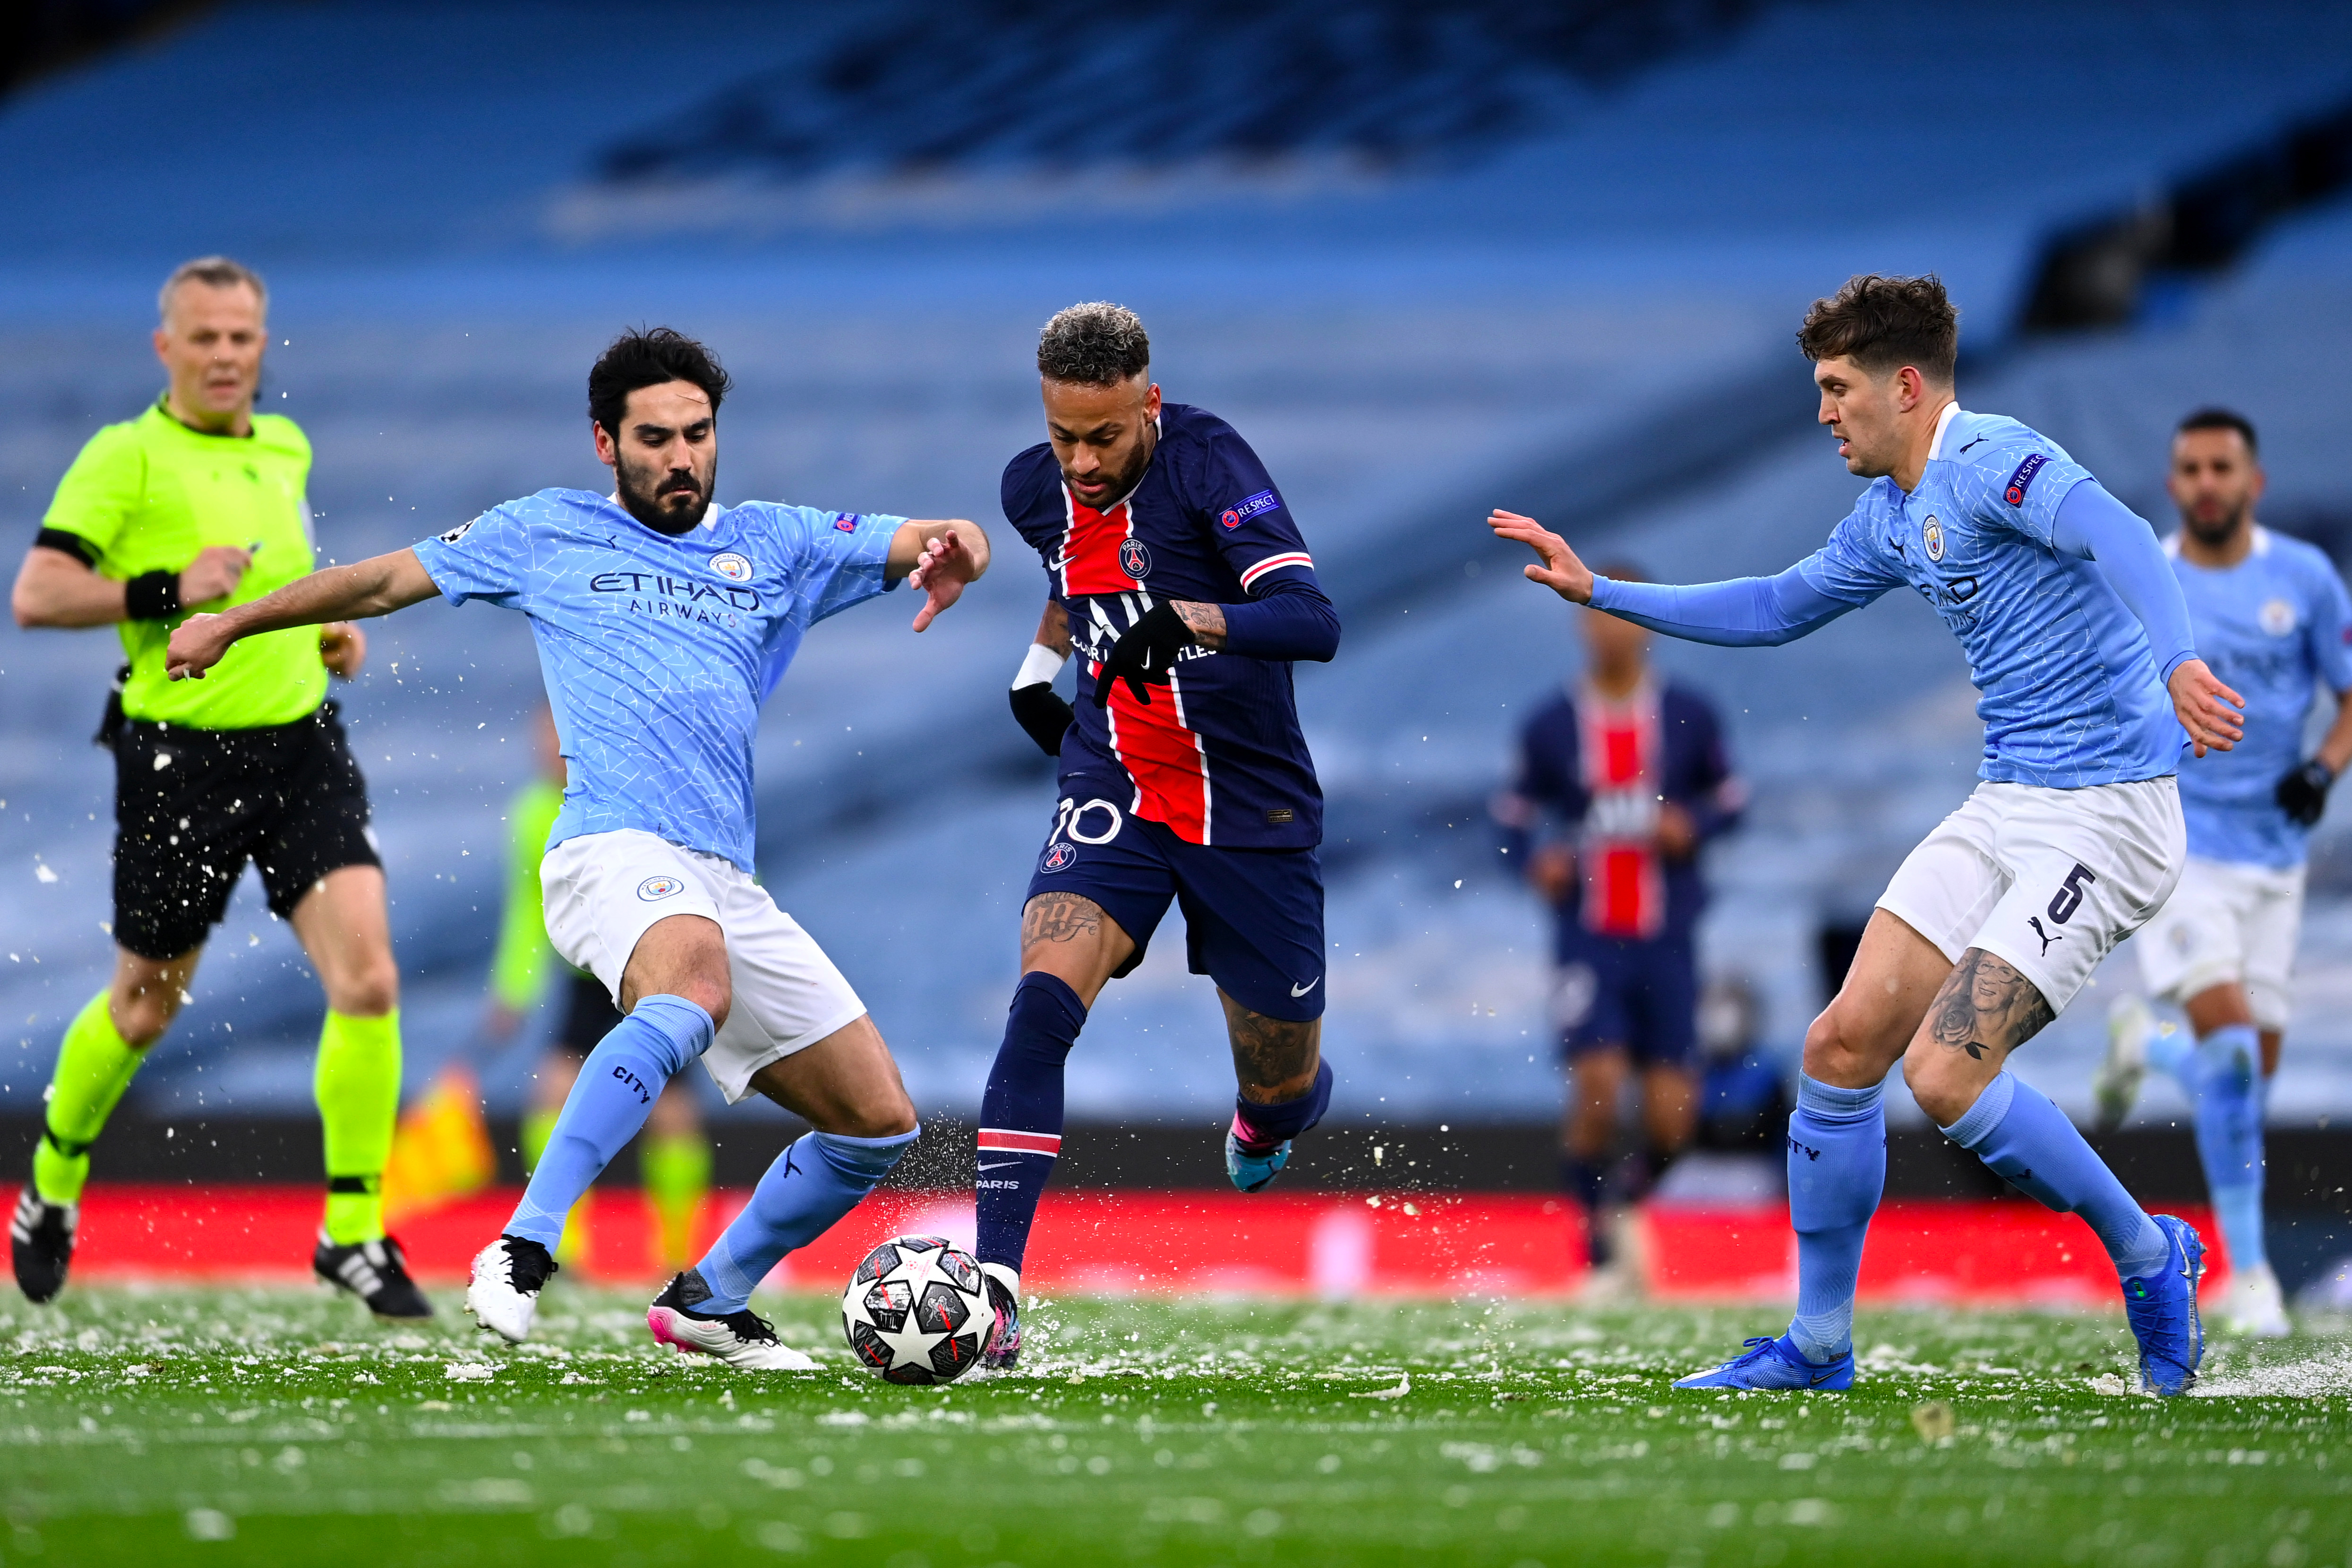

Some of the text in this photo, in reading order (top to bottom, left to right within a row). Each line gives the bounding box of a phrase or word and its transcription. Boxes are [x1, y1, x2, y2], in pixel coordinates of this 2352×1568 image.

[2014, 454, 2045, 488] RESPEC
[1237, 494, 1275, 518] RESPECT
[711, 554, 745, 566] MANCHESTER
[1122, 541, 1143, 551] PARIS
[590, 572, 760, 611] ETIHAD
[630, 599, 736, 628] AIRWAYS
[1943, 610, 1977, 630] RWAYS
[1048, 797, 1122, 847] 10
[1049, 844, 1072, 854] PARIS
[2047, 862, 2096, 925] 5
[612, 1066, 650, 1104] CITY
[1786, 1133, 1821, 1161] ITY
[975, 1180, 1020, 1190] PARIS
